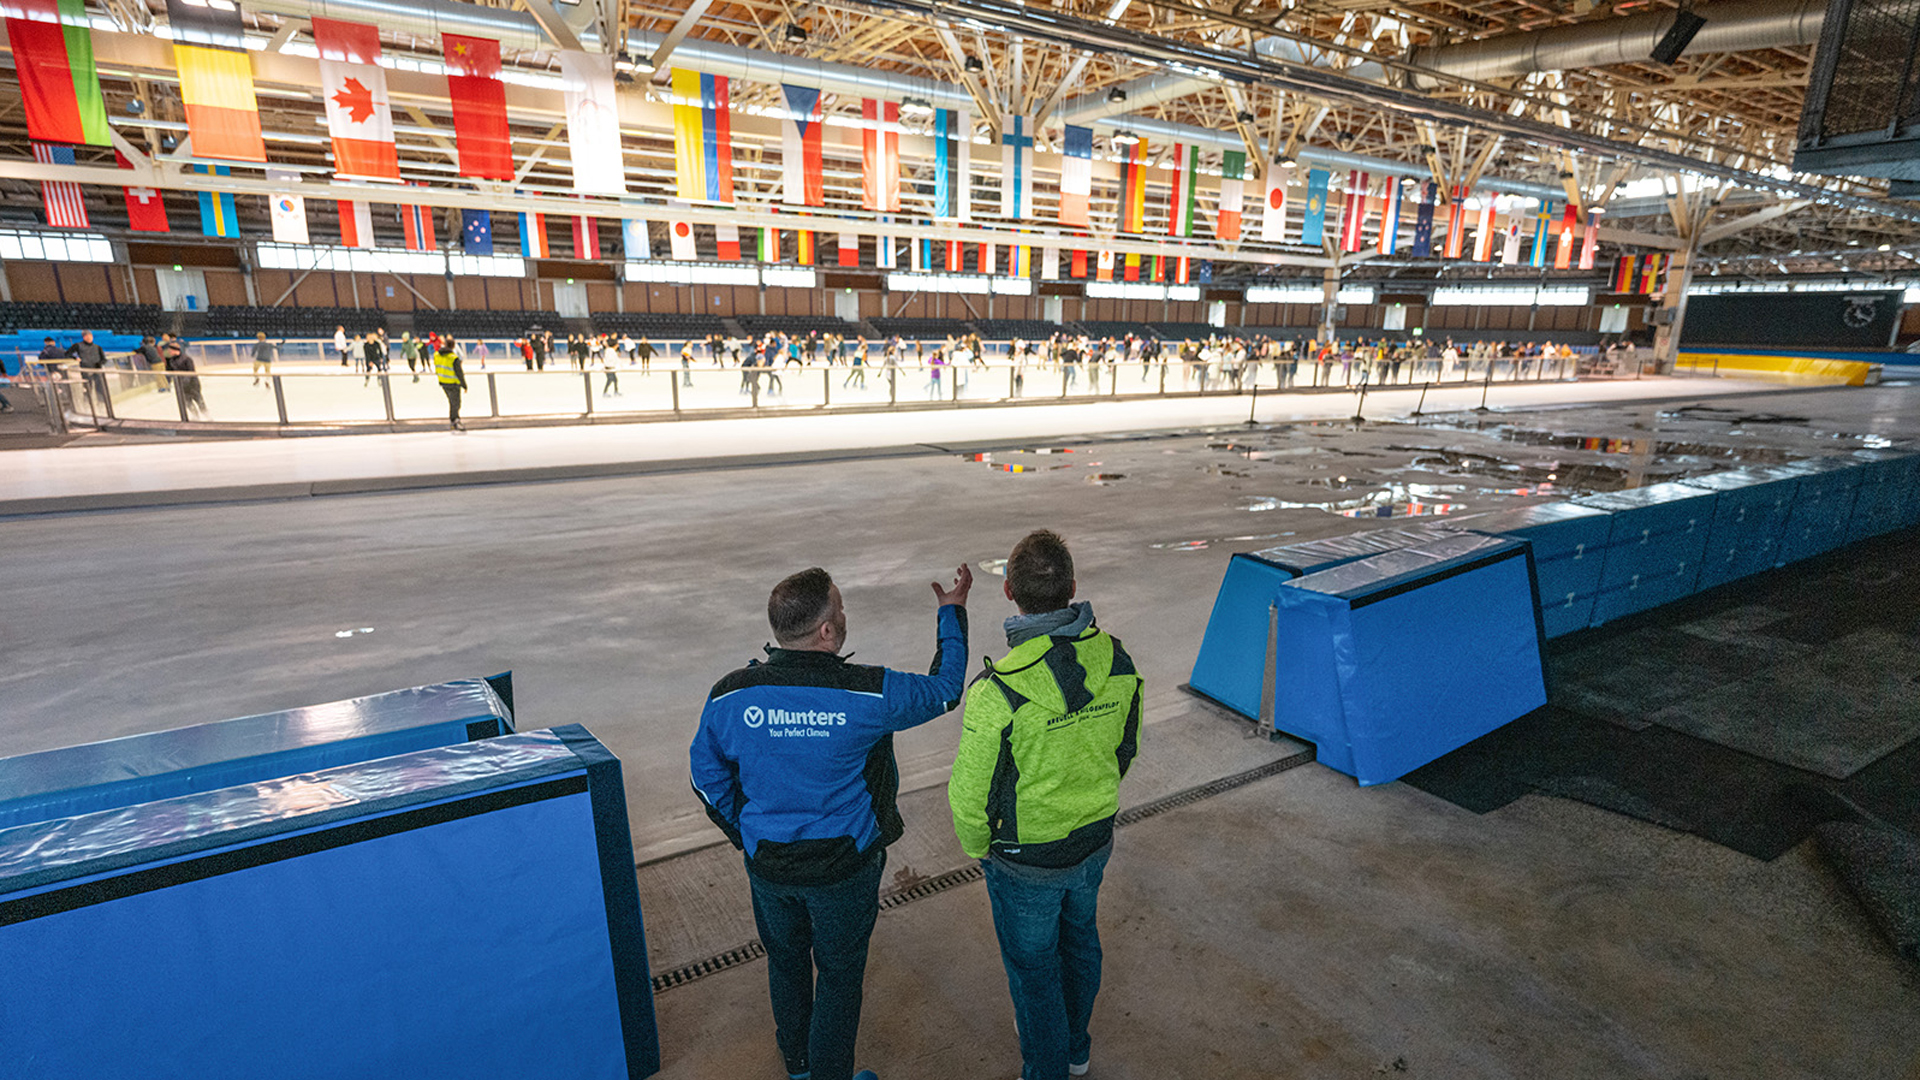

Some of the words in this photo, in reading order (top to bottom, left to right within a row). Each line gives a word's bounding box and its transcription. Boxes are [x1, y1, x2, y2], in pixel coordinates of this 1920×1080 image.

[767, 709, 847, 726] Munters
[768, 728, 783, 737] Your
[784, 727, 805, 737] Perfect
[806, 727, 830, 737] Climate
